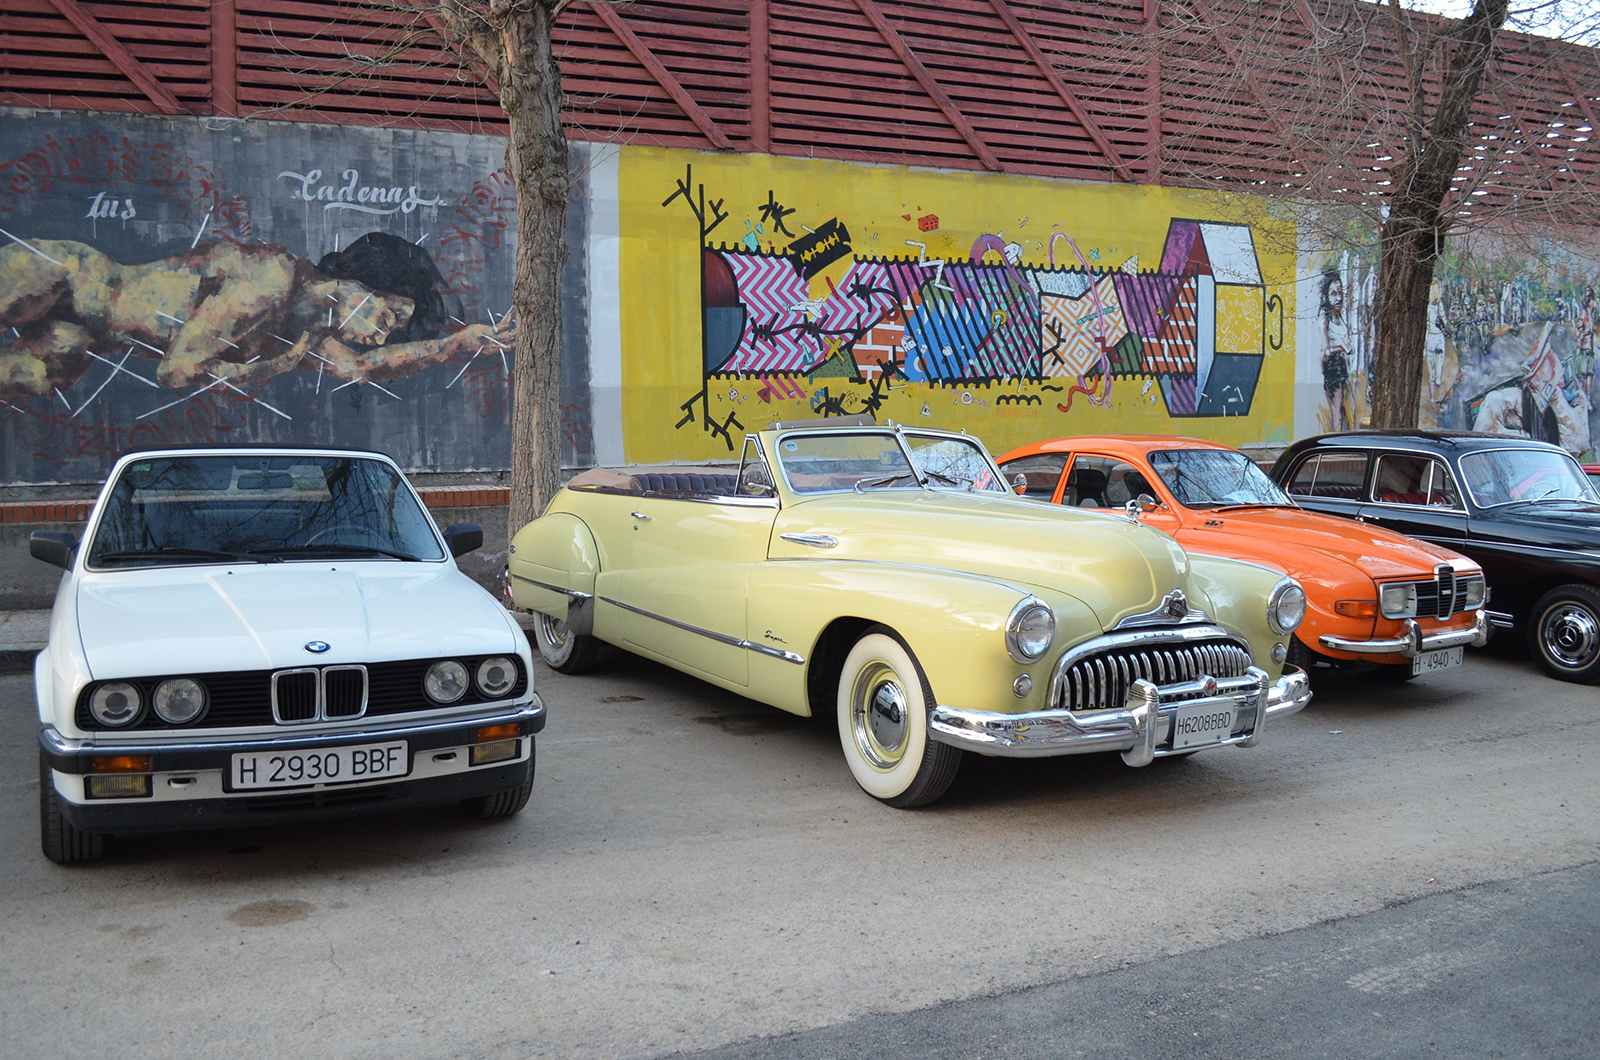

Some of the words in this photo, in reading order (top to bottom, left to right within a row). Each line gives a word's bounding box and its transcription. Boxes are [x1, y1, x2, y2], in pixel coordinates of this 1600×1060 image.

[277, 168, 447, 214] Cadenas
[1177, 711, 1231, 735] H6208BBD
[240, 758, 257, 783] H
[269, 753, 340, 782] 2930
[352, 746, 402, 775] BBF
